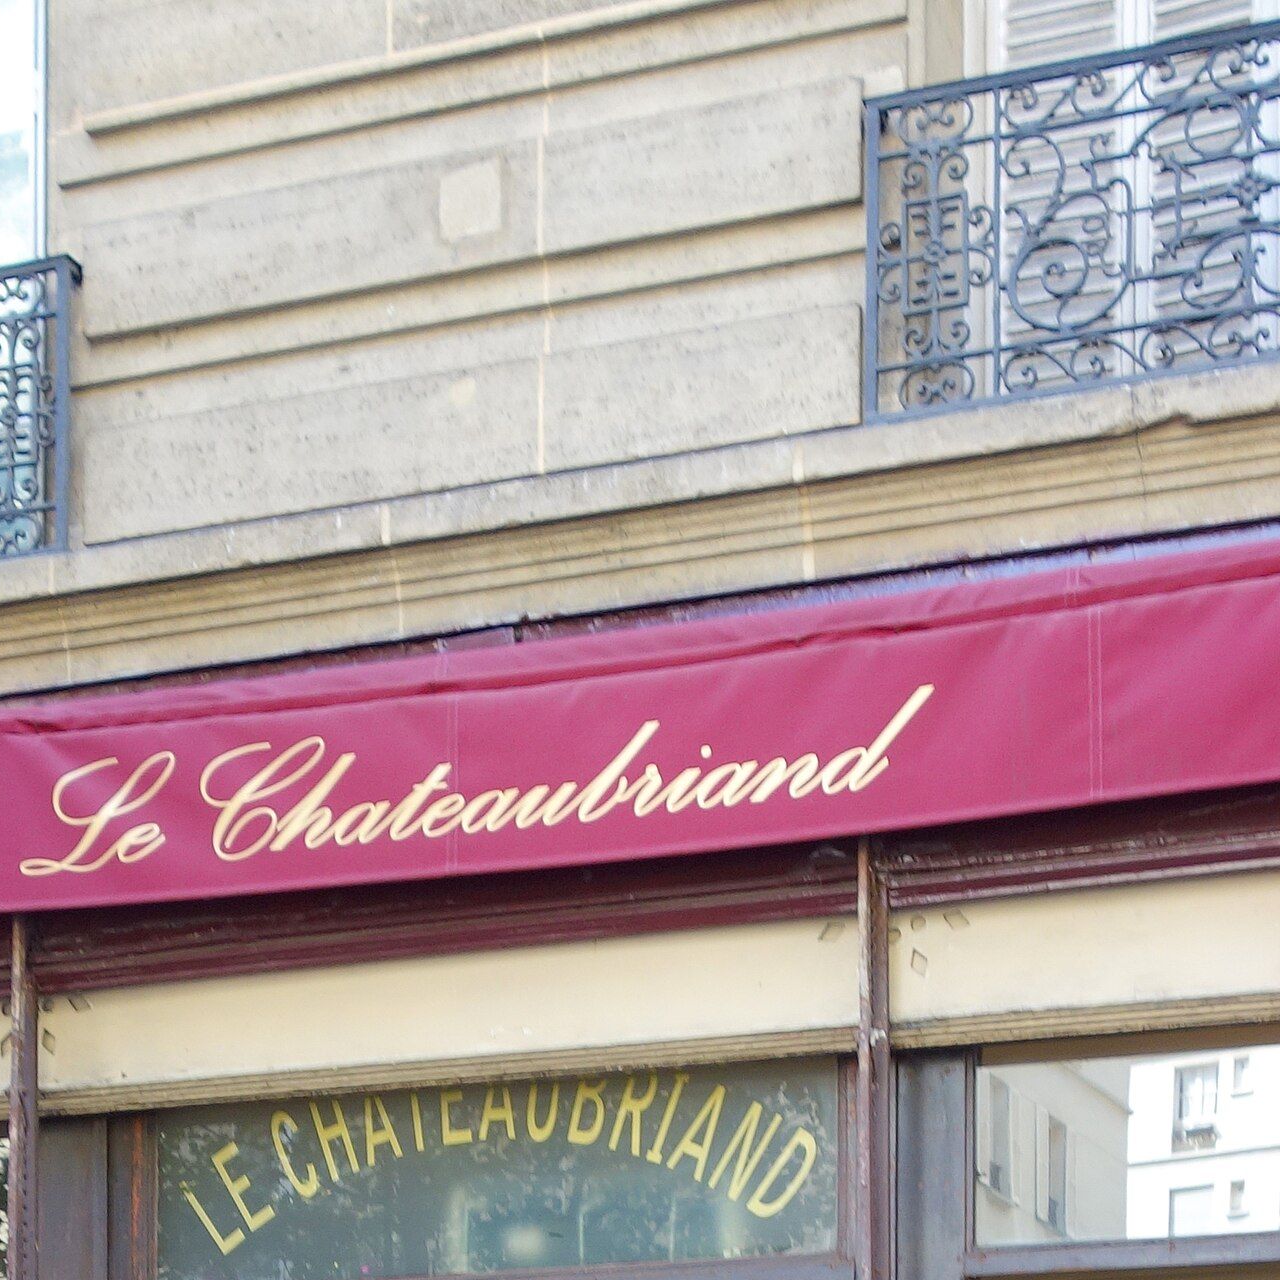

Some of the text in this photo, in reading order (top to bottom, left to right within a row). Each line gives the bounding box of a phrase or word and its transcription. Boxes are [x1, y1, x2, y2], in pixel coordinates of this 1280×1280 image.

[19, 683, 936, 876] Le Chateaubriand
[182, 1074, 818, 1256] LE CHATEAUBRIAND
